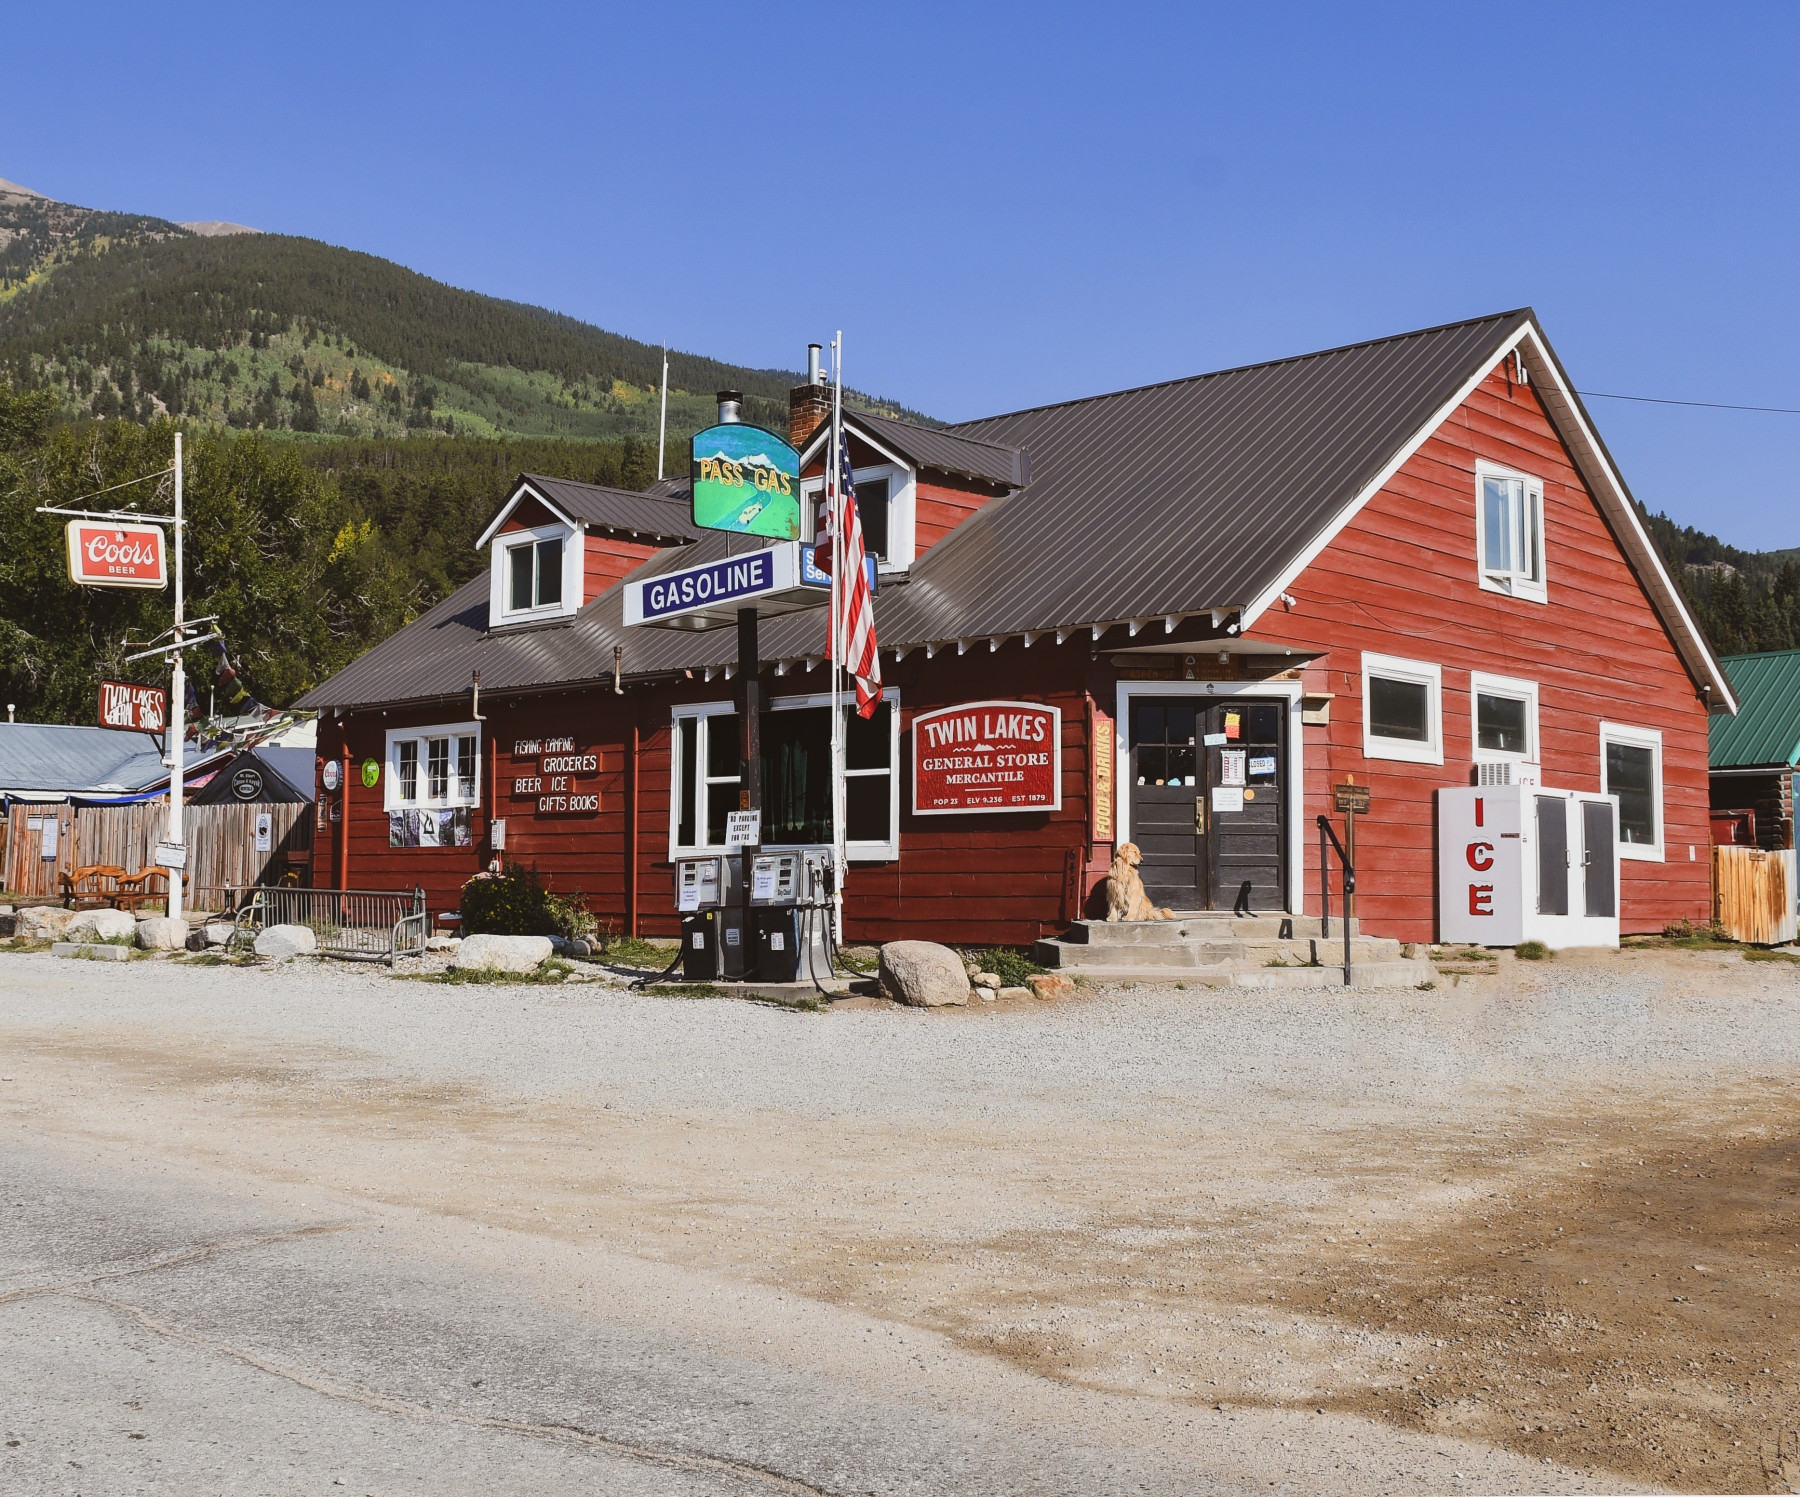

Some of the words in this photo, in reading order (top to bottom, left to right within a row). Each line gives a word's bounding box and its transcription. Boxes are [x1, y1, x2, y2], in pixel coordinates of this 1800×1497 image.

[701, 459, 744, 487] PASS
[755, 468, 791, 495] GAS
[85, 536, 155, 565] Coors
[108, 566, 136, 574] BEER
[650, 559, 764, 610] GASOLINE
[103, 684, 131, 719] TWIN
[133, 688, 163, 726] LAKES
[924, 716, 977, 748] TWIN
[984, 714, 1047, 742] LAKES
[515, 739, 542, 754] FISHING
[545, 737, 574, 753] CAMPING
[1096, 725, 1111, 777] DRINKS
[923, 755, 992, 771] GENERAL
[996, 752, 1049, 767] STORE
[516, 778, 542, 792] BEER
[551, 776, 568, 791] ICE
[946, 771, 1024, 784] MERCANTILE
[1097, 780, 1111, 792] &
[539, 796, 566, 811] GIFTS
[570, 795, 598, 811] BOOKS
[1096, 796, 1111, 834] FOOD
[733, 824, 750, 832] EXCEPT
[1466, 796, 1494, 916] ICE
